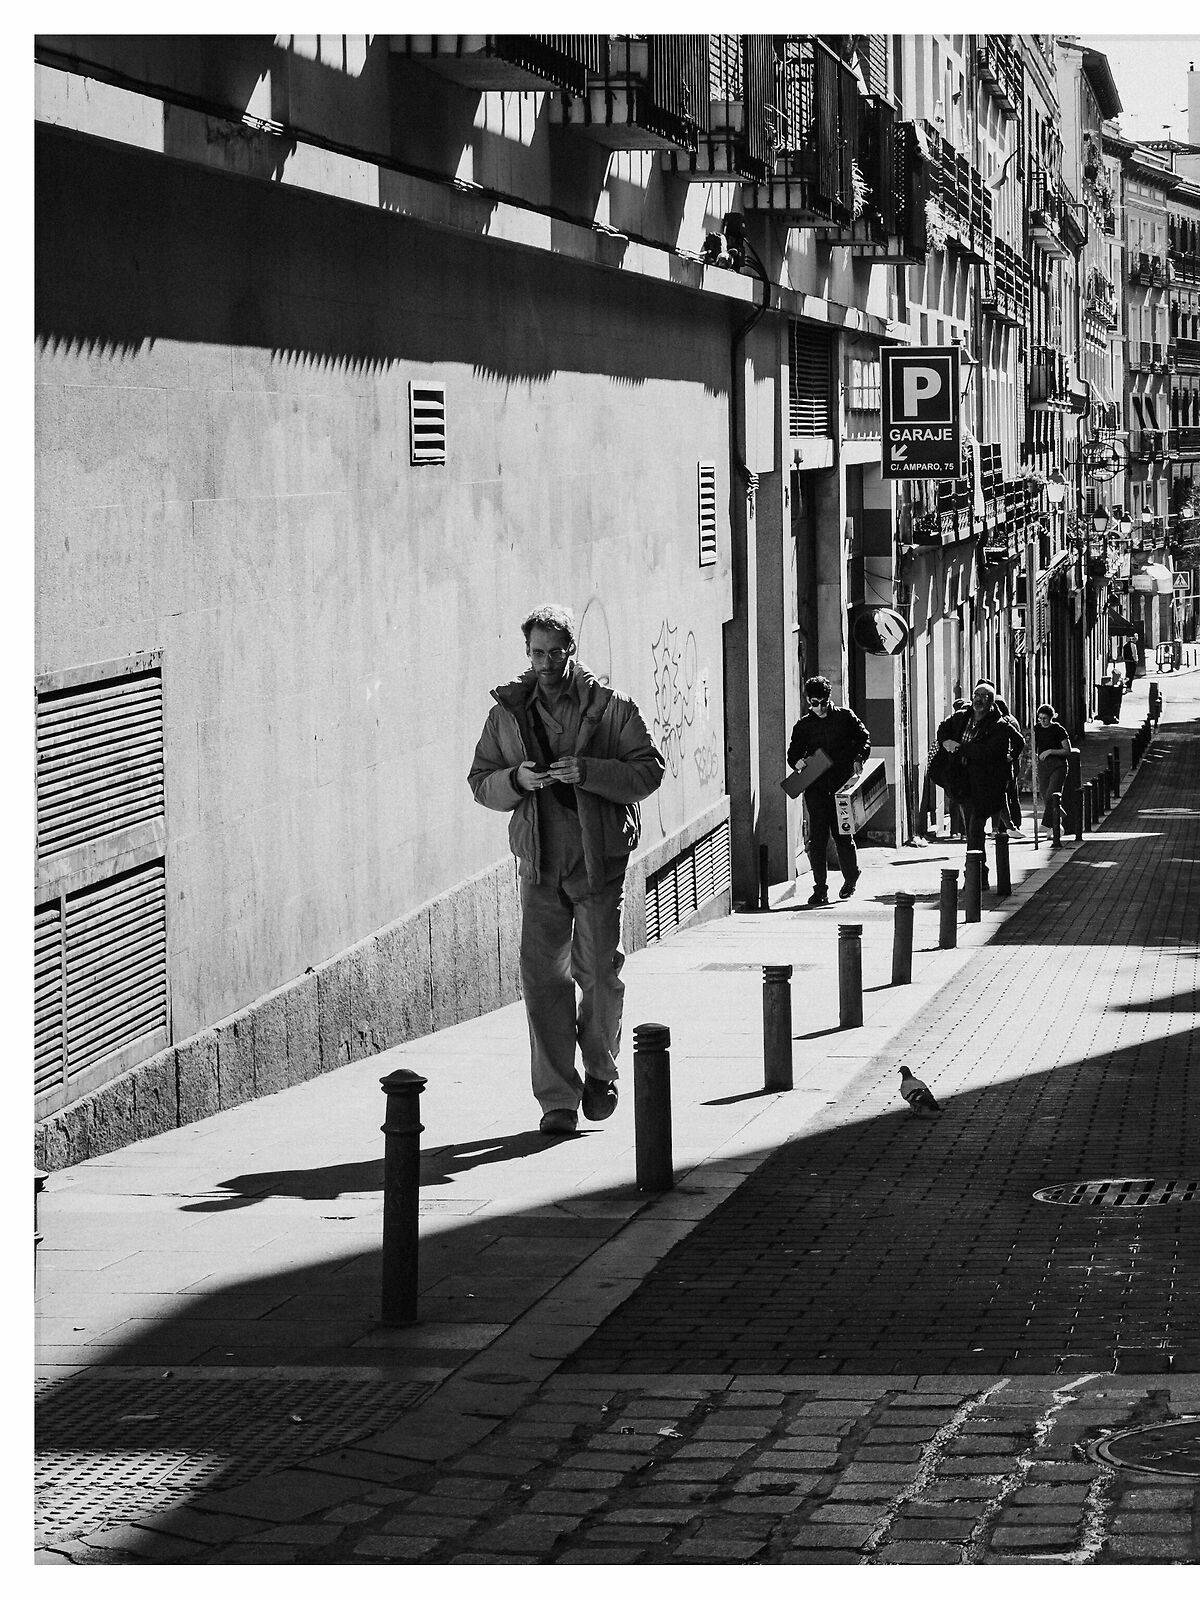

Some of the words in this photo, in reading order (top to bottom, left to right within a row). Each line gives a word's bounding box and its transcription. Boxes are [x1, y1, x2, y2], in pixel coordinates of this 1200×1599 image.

[903, 366, 942, 417] P
[889, 428, 953, 441] GARAJE
[903, 463, 943, 472] AMPARO,
[944, 462, 954, 471] 75
